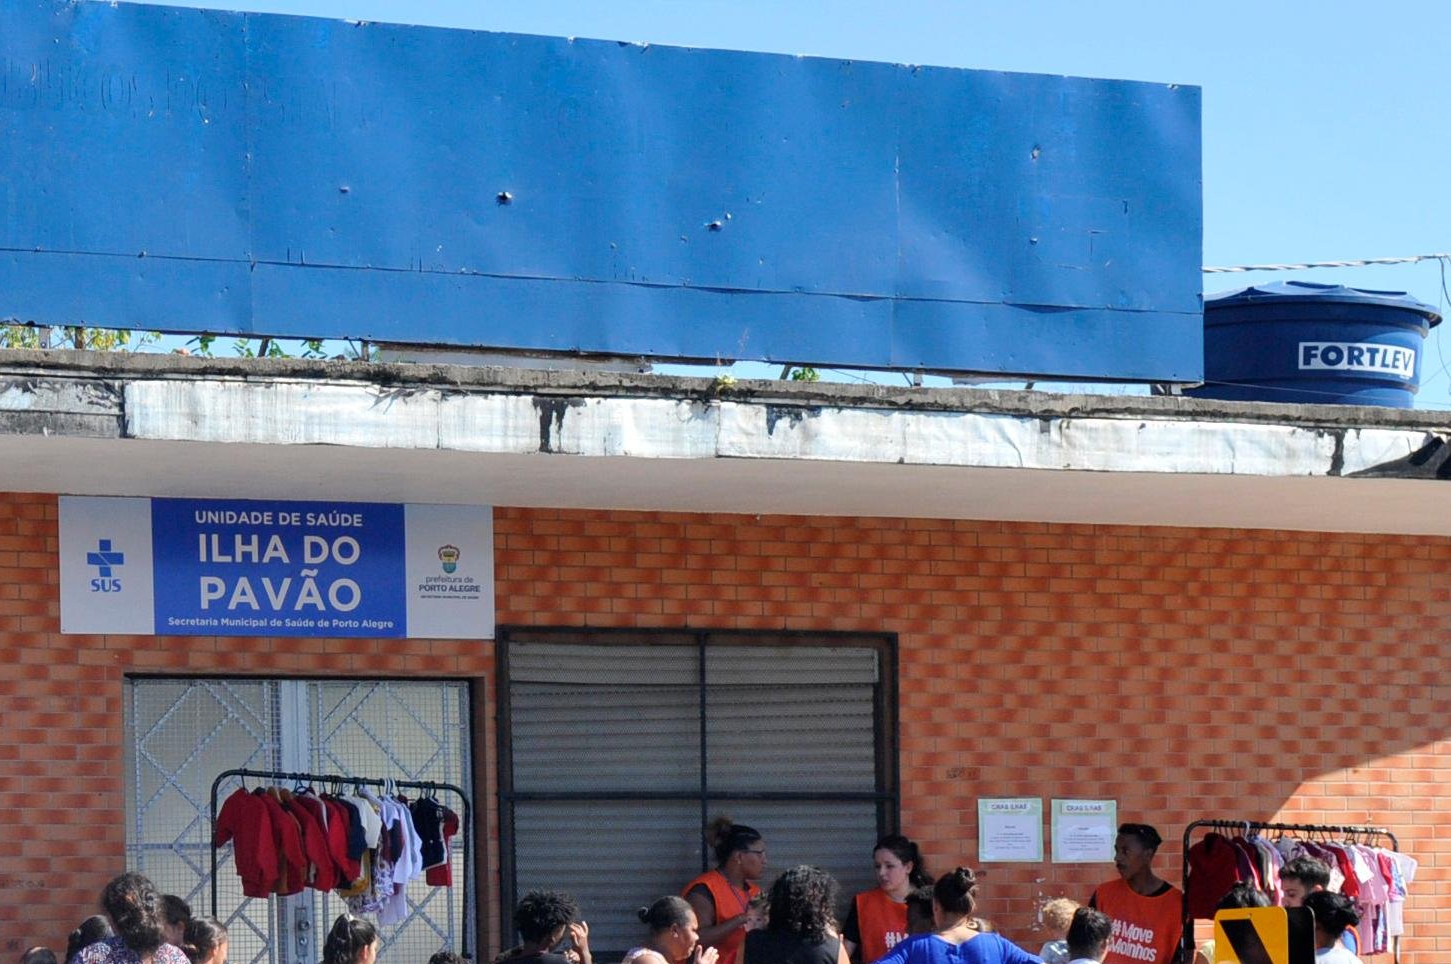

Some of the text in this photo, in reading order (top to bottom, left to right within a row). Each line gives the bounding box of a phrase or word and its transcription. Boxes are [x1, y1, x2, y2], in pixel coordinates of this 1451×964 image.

[1302, 344, 1413, 372] FORTLEV
[194, 510, 364, 527] UNIDADE DE SAÚDE
[198, 533, 361, 565] ILHA DO
[90, 578, 122, 593] SUS
[199, 568, 362, 612] PAVÃO
[418, 584, 481, 593] PORTO ALEGRE
[168, 617, 394, 630] Secretaria Municipal de Saúde de Porto Alegre
